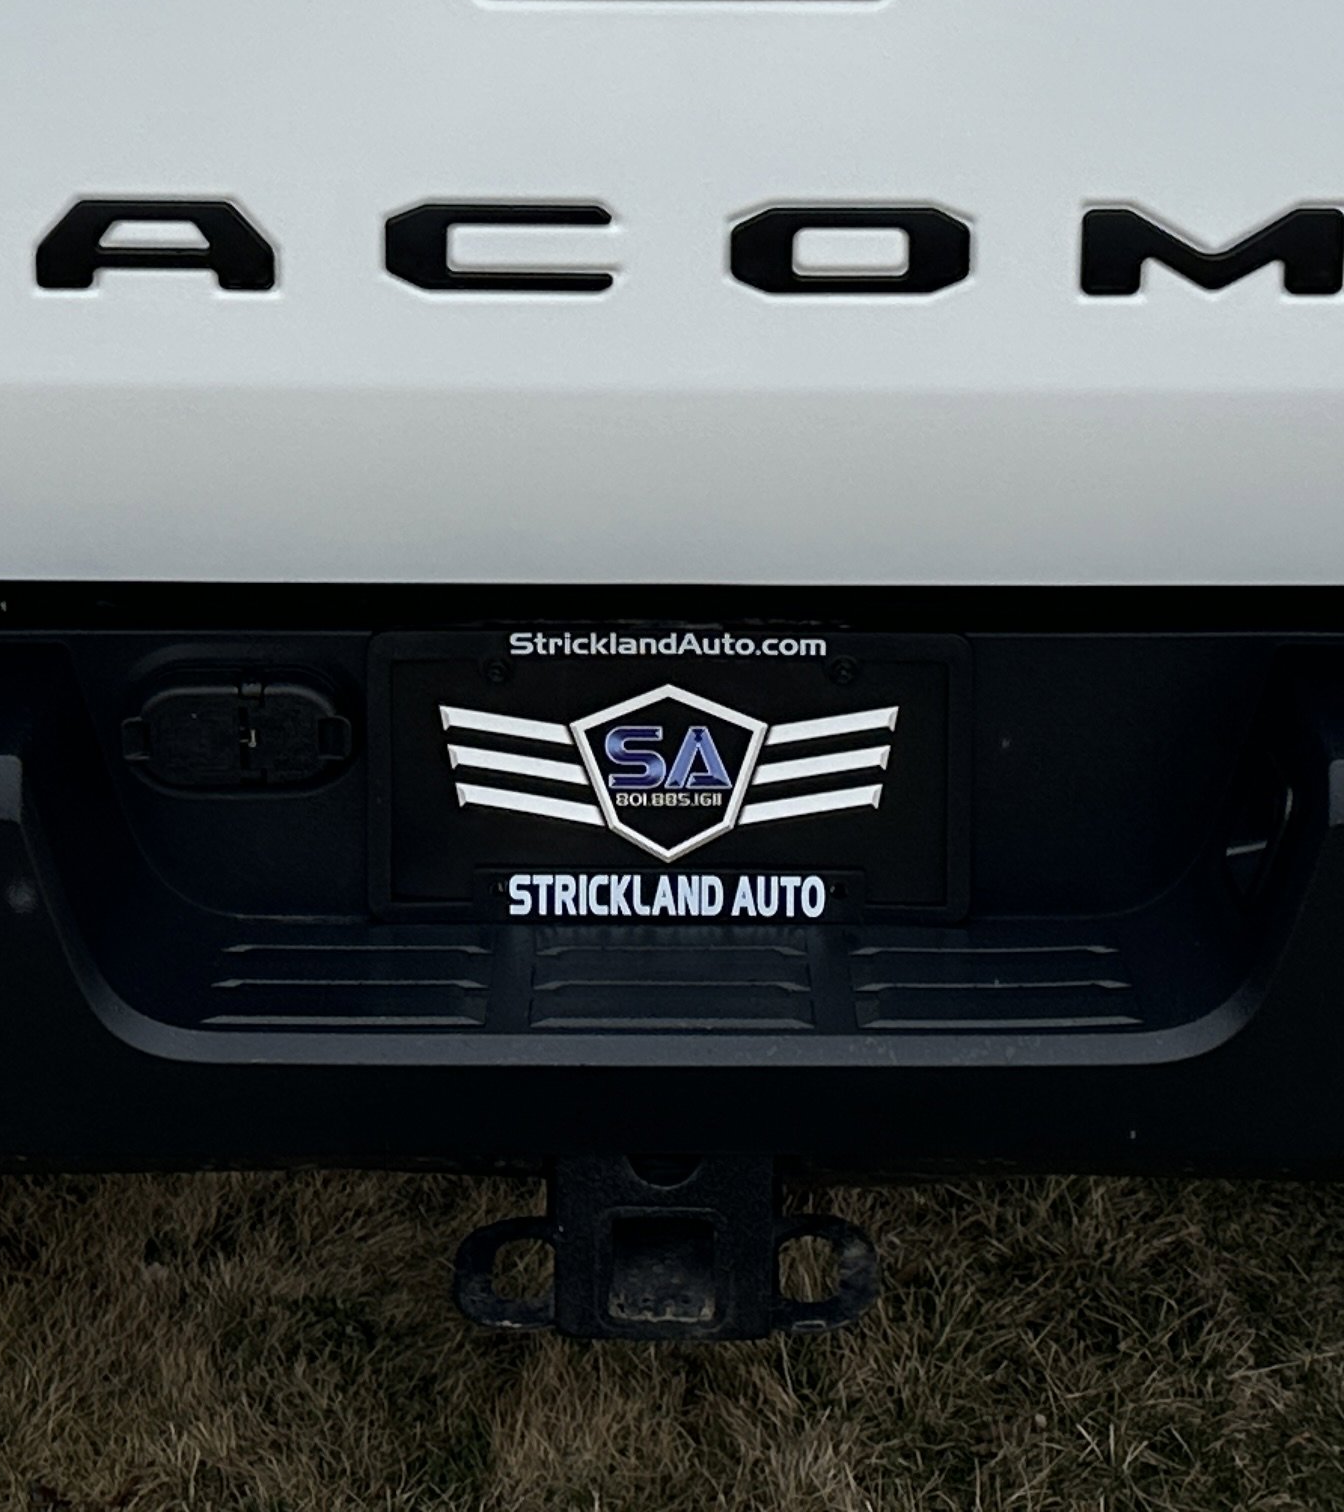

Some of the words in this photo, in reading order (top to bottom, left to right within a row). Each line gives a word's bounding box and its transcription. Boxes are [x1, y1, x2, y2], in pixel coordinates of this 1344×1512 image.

[509, 632, 827, 656] StricklandAuto.com
[604, 725, 733, 789] SA
[615, 792, 723, 807] 801.885.1611
[509, 874, 724, 917] STRICKLAND
[731, 875, 826, 918] AUTO
